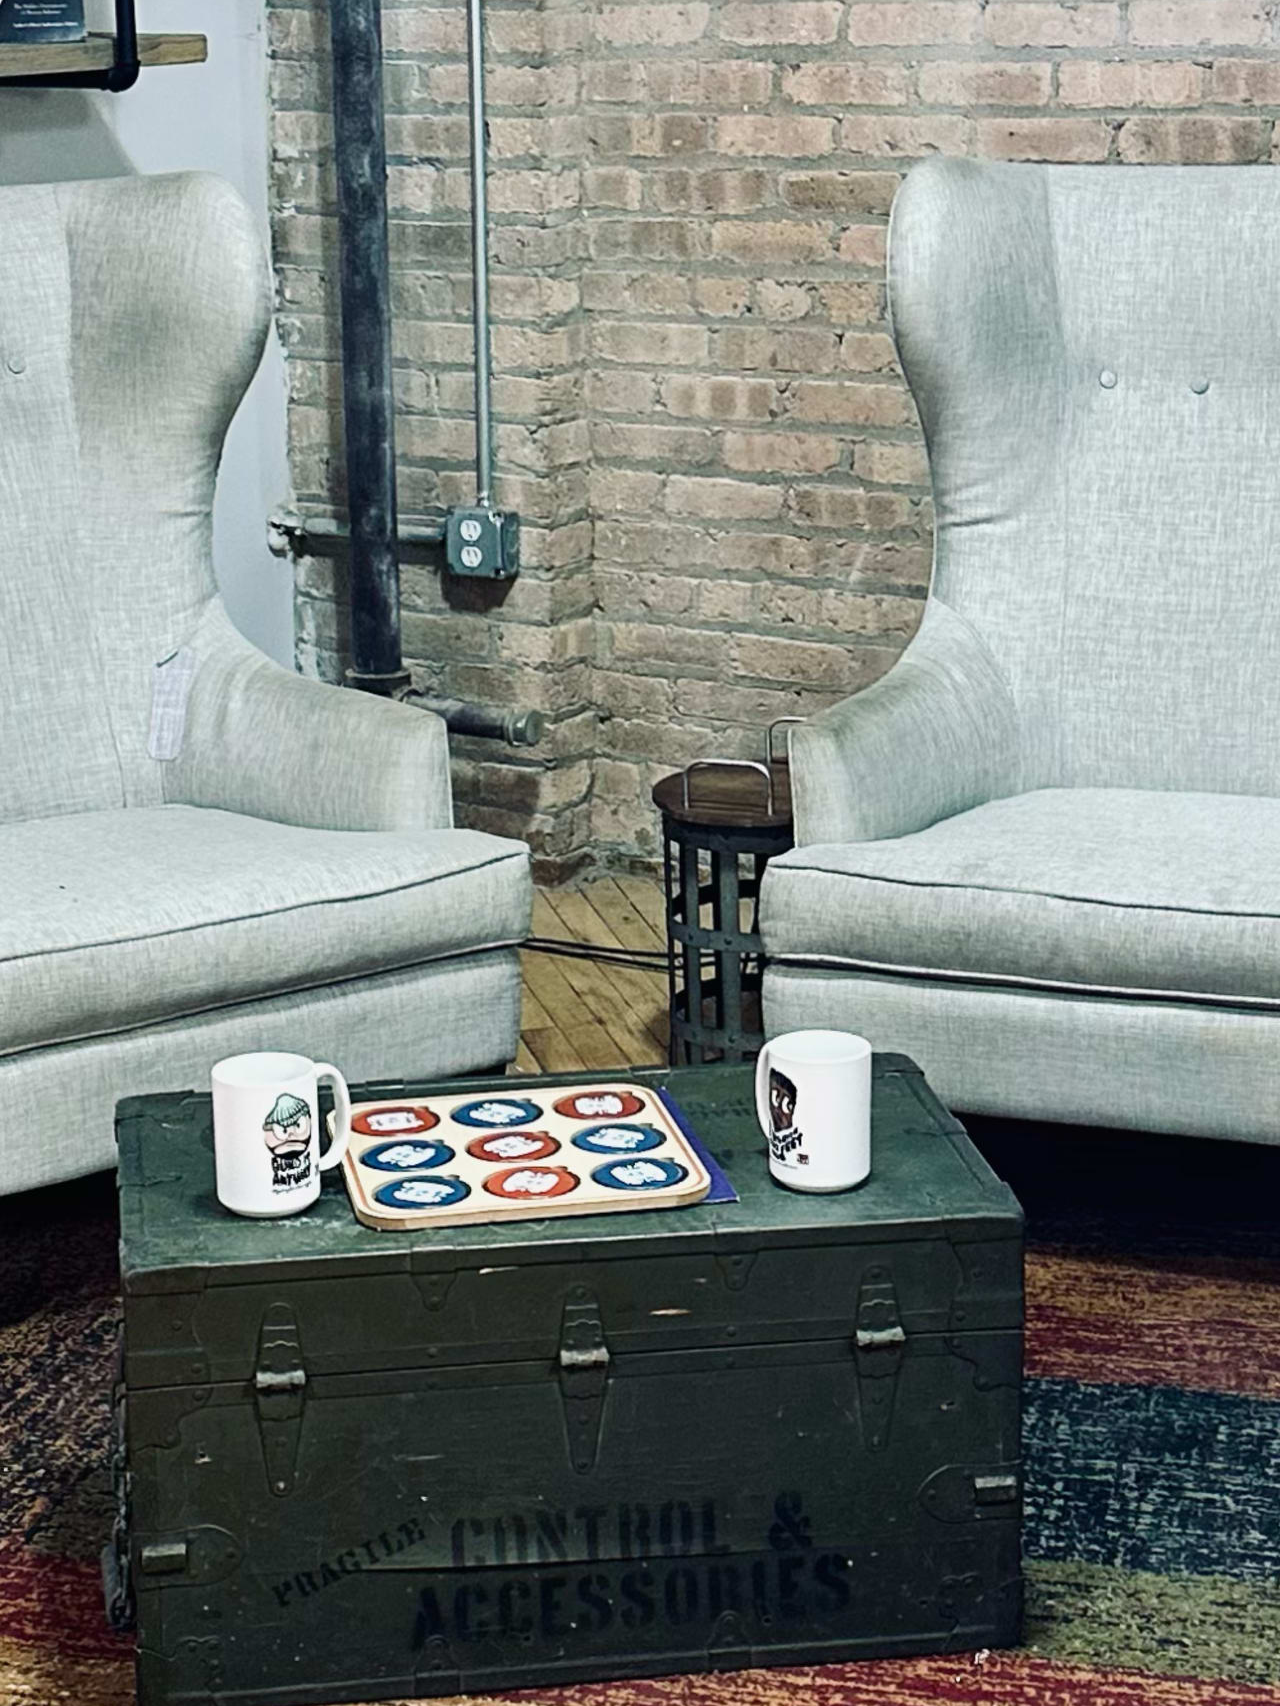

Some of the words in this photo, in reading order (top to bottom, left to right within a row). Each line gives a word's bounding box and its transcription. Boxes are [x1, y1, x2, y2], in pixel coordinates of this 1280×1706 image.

[273, 1517, 426, 1609] FRAGILE
[451, 1498, 731, 1567] CONTROL
[768, 1491, 814, 1552] &
[410, 1552, 852, 1651] ACCESSORIES
